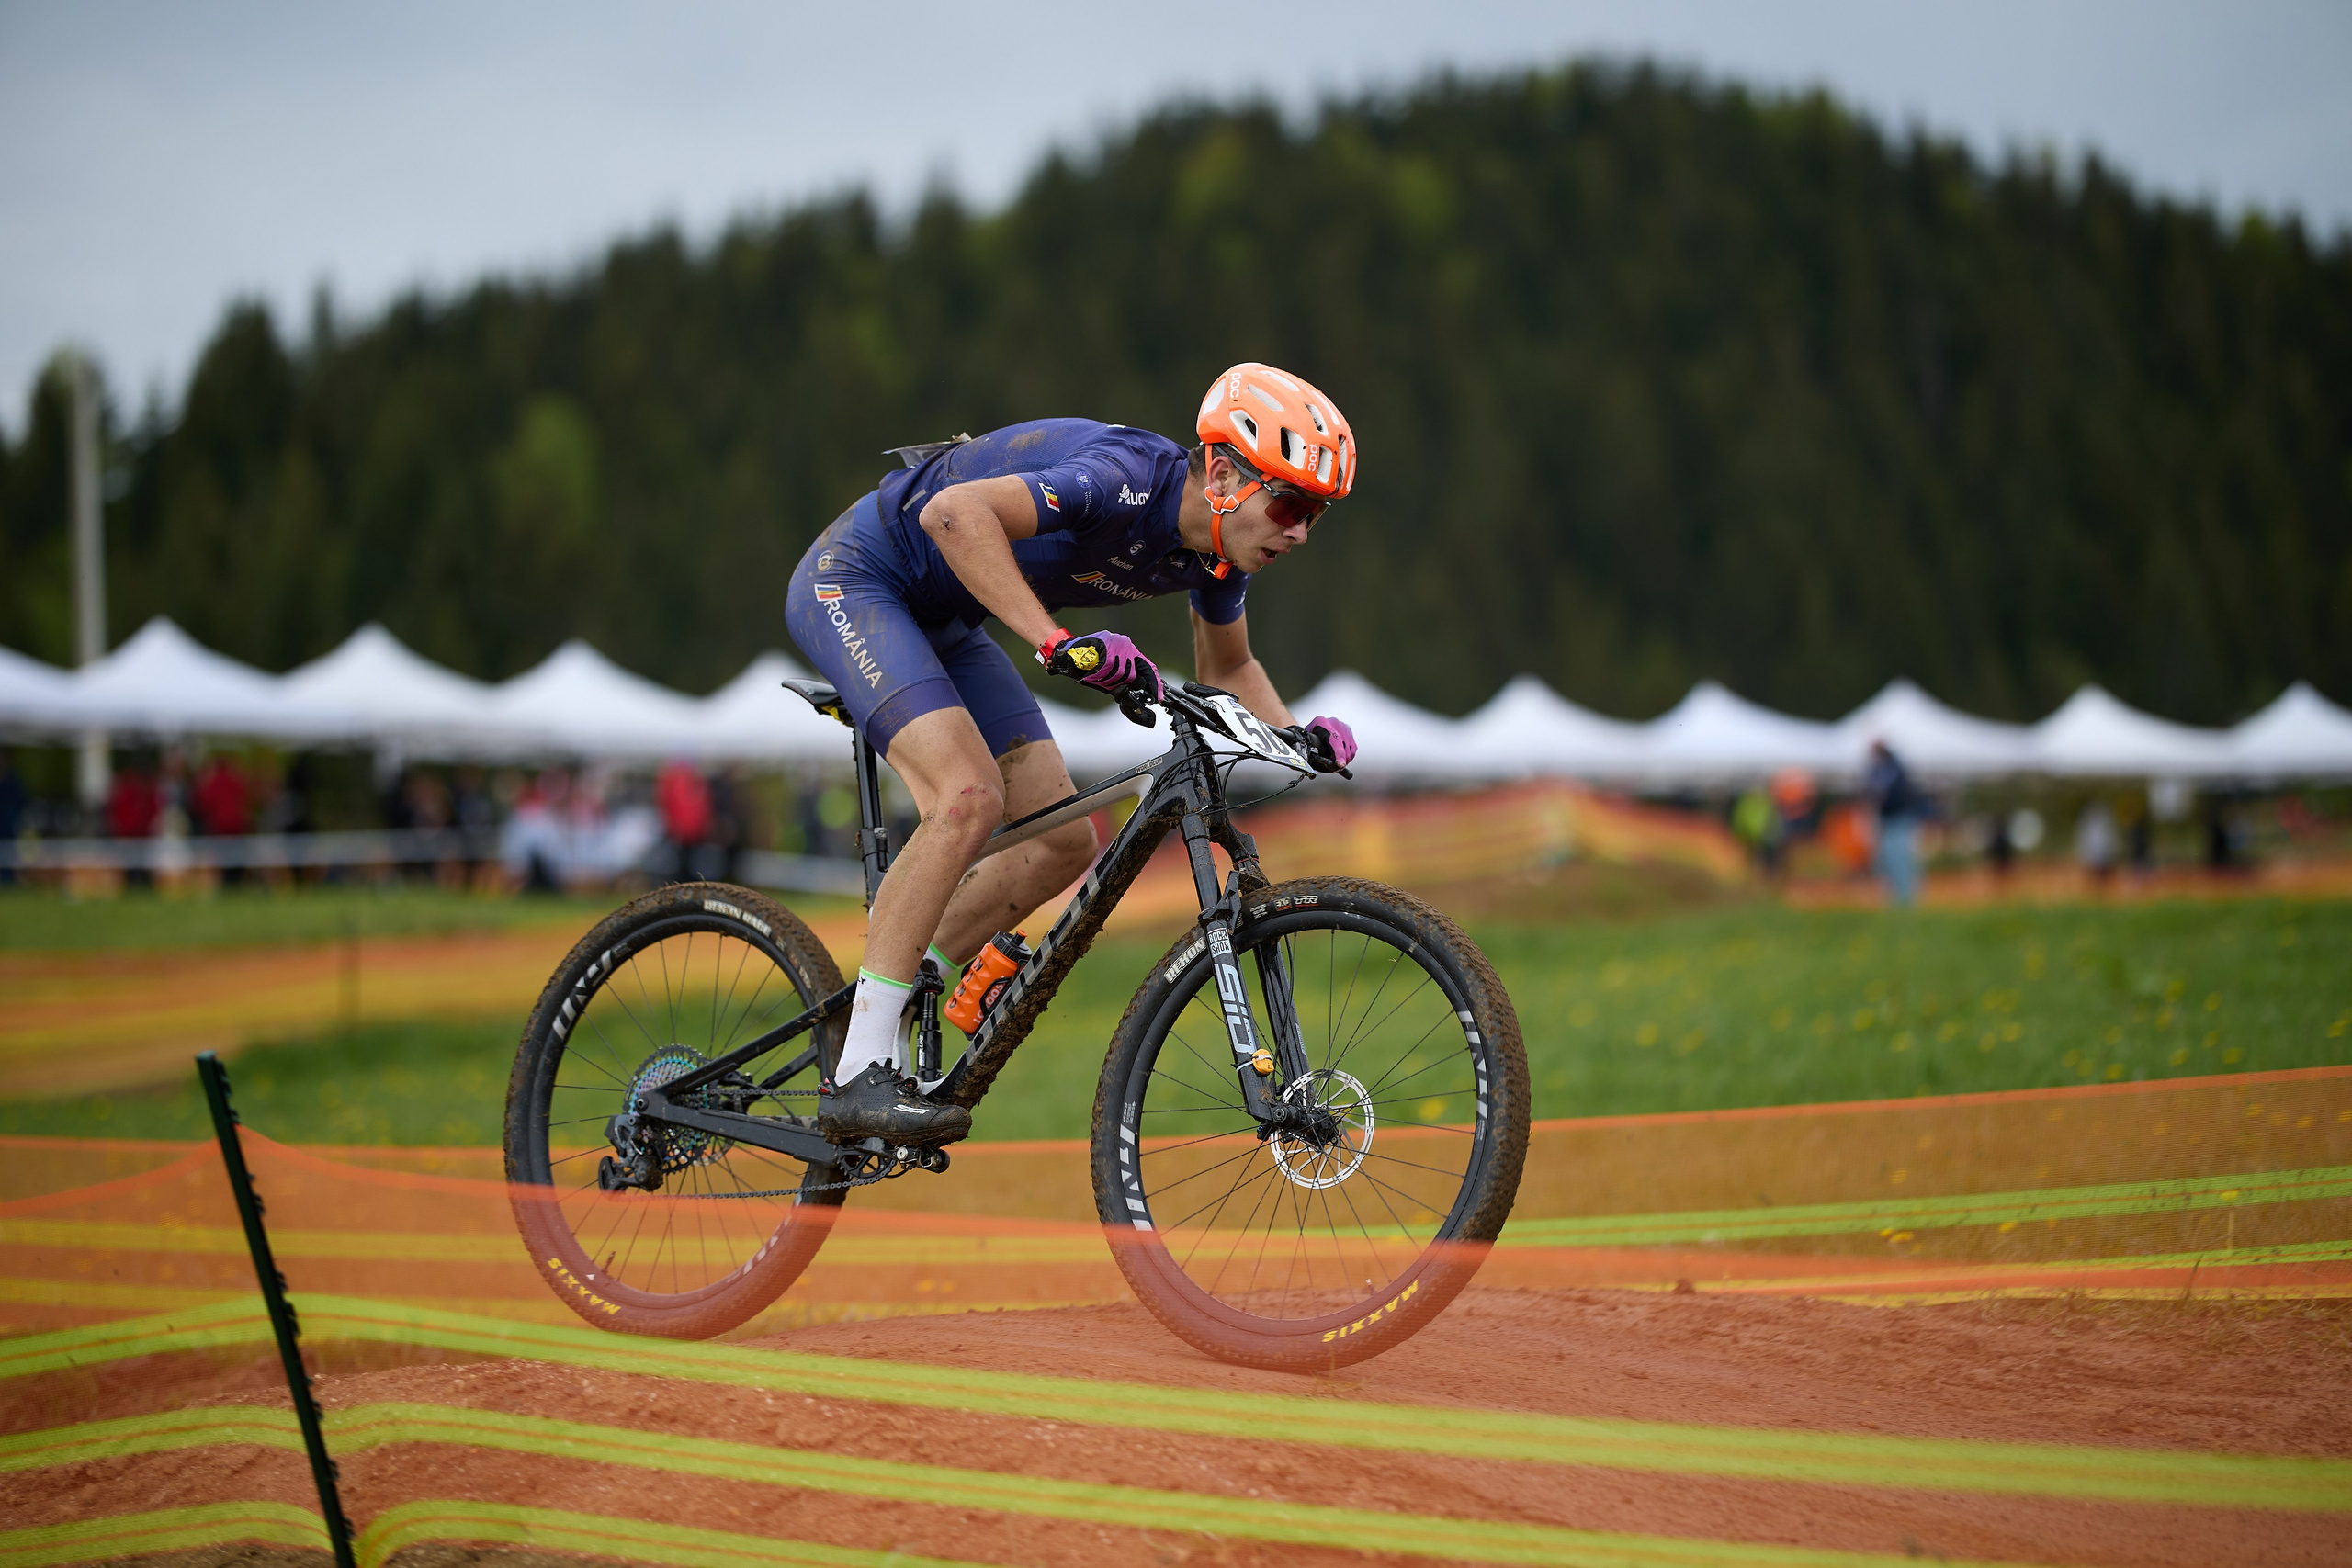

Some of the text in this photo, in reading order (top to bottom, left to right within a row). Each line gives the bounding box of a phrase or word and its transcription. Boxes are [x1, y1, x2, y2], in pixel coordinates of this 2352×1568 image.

[1230, 372, 1241, 399] POC
[1307, 444, 1318, 472] POC
[823, 598, 883, 689] ROMÂNIA
[1208, 929, 1228, 943] ROCK
[1211, 942, 1230, 956] SHOX
[548, 1258, 622, 1315] MAXXIS
[1322, 1280, 1419, 1343] MAXXIS
